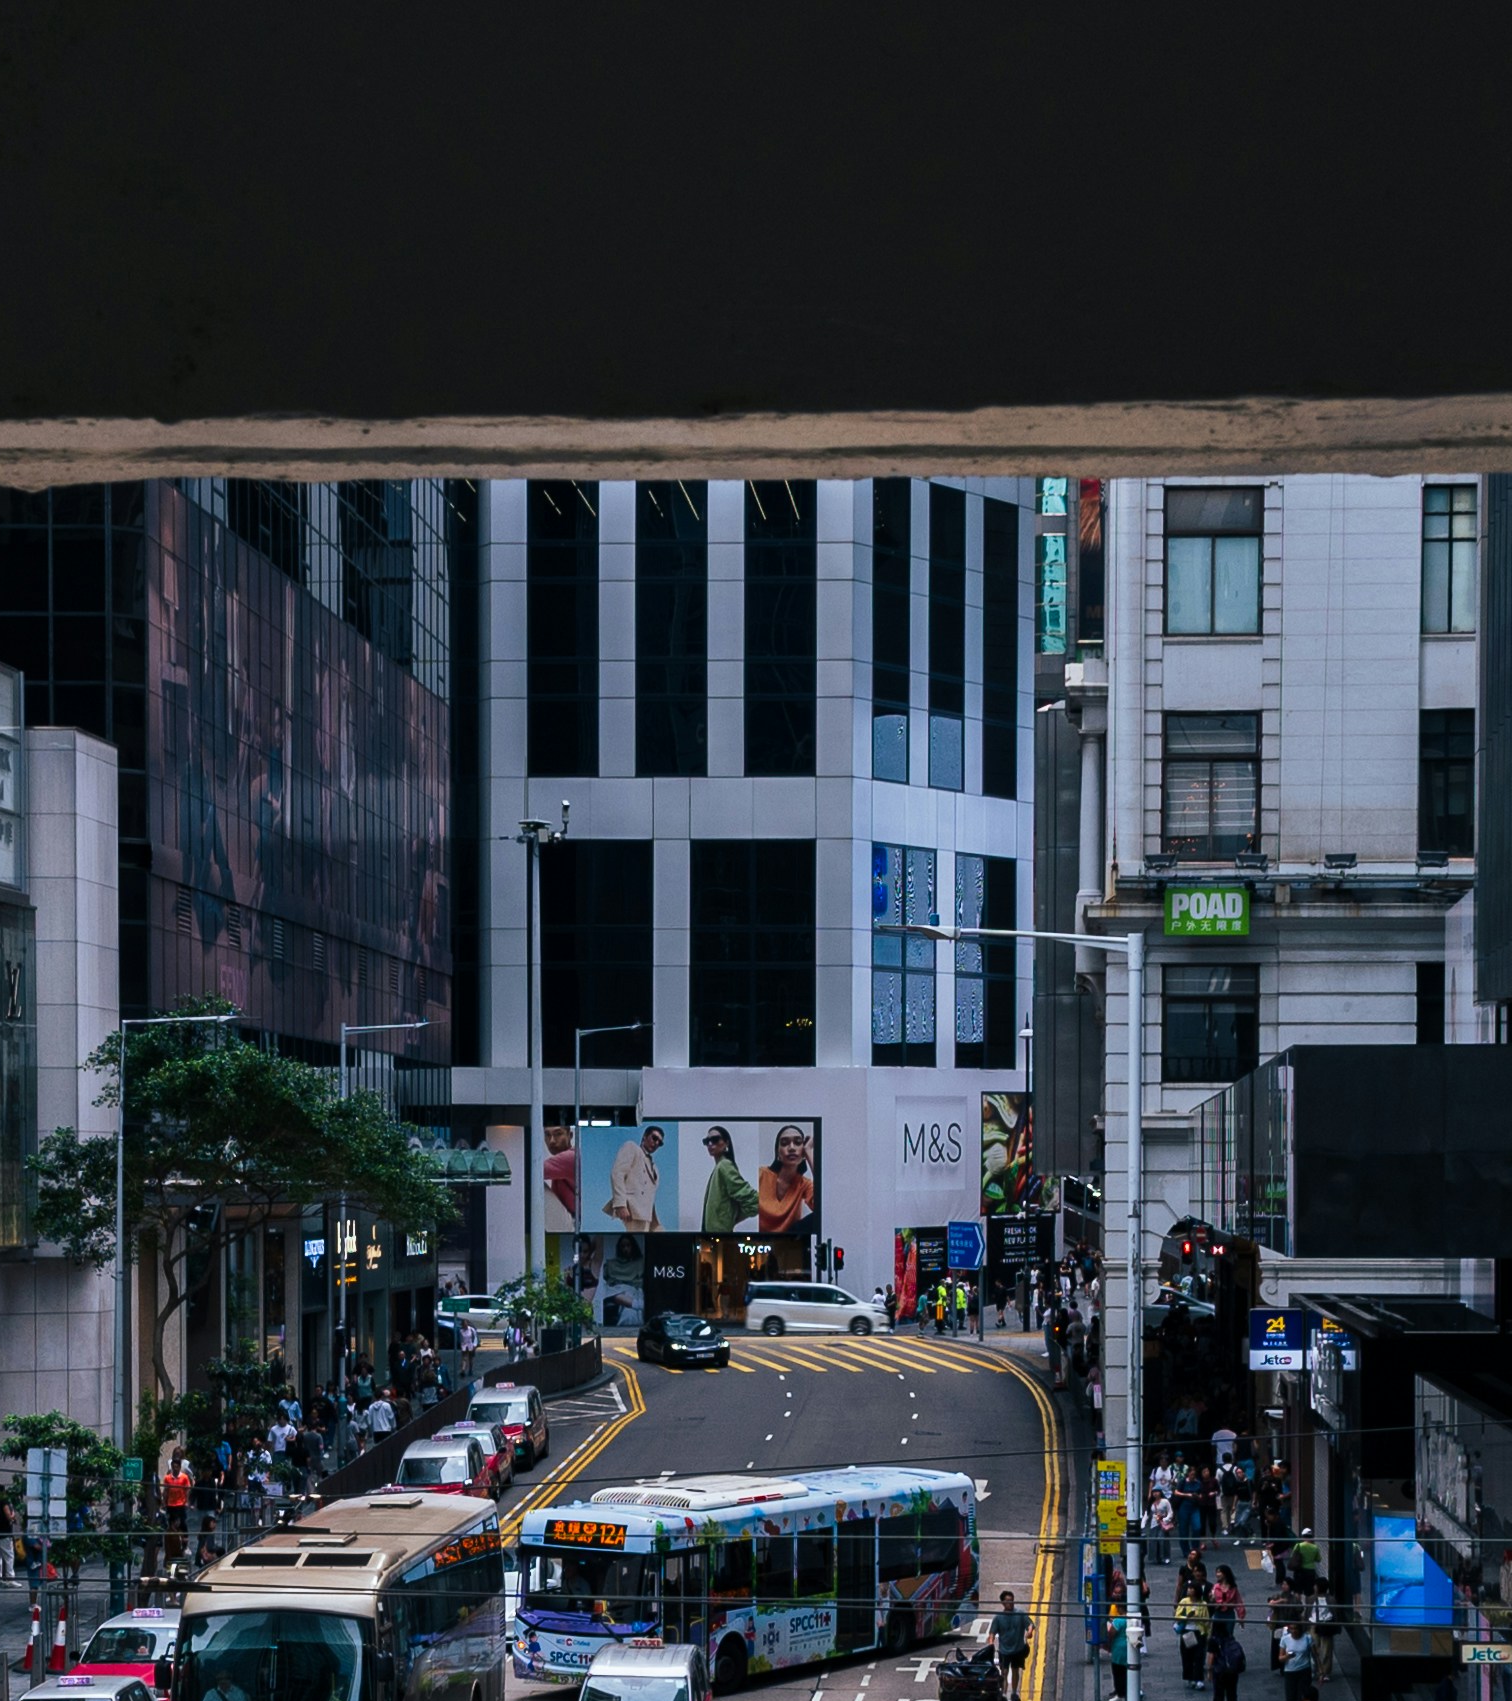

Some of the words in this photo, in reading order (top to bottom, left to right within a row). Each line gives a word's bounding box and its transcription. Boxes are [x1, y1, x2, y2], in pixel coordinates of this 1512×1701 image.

[1171, 892, 1243, 920] POAD
[903, 1122, 962, 1164] M&S
[653, 1265, 686, 1279] M&S
[599, 1523, 625, 1545] 12A
